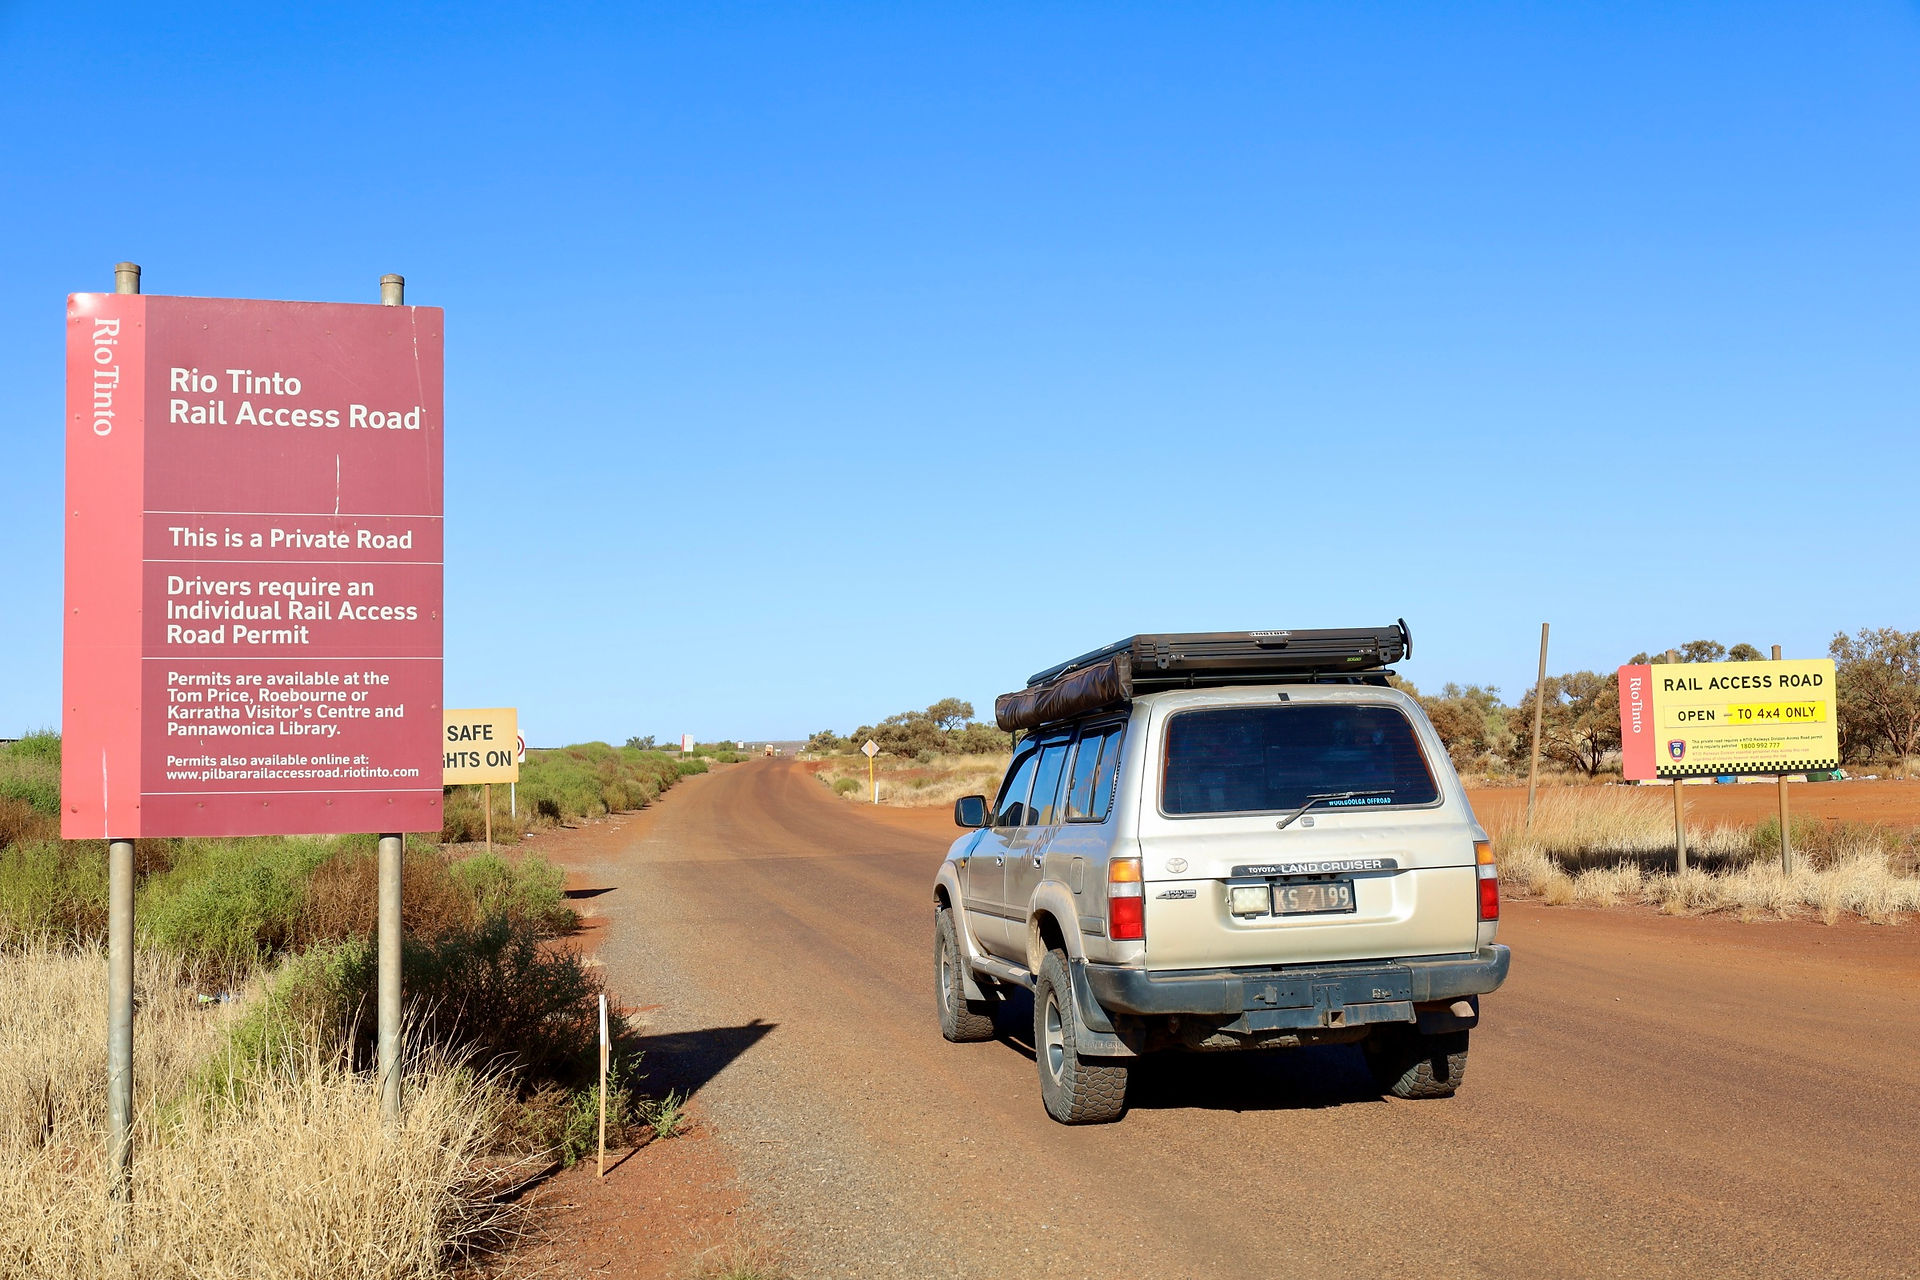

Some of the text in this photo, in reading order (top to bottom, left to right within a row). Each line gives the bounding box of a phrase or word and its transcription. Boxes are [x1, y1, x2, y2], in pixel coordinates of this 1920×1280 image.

[170, 367, 302, 396] Rio Tinto
[170, 398, 421, 430] Rail Access Road
[168, 526, 412, 550] This is a Private Road
[167, 575, 374, 600] Drivers require an
[167, 599, 418, 621] Individual Rail Access
[167, 624, 310, 645] Road Permit
[168, 671, 390, 686] Permits are available at the
[1664, 673, 1823, 691] RAIL ACCESS ROAD
[167, 687, 369, 705] Tom Price, Roebourne or
[167, 703, 404, 720] Karratha Visitor's Centre and
[1677, 710, 1715, 722] OPEN
[1738, 708, 1752, 720] TO
[1757, 707, 1780, 719] 4x4
[1785, 706, 1816, 718] ONLY
[167, 721, 341, 738] Pannawonica Library.
[447, 724, 494, 742] SAFE
[167, 753, 369, 767] Permits also available online at:
[486, 750, 512, 767] ON
[166, 766, 420, 781] www.pilbararailaccessroad.riotinto.com
[1281, 863, 1319, 873] LAND
[1321, 860, 1383, 870] CRUISER
[1307, 886, 1349, 908] 2199
